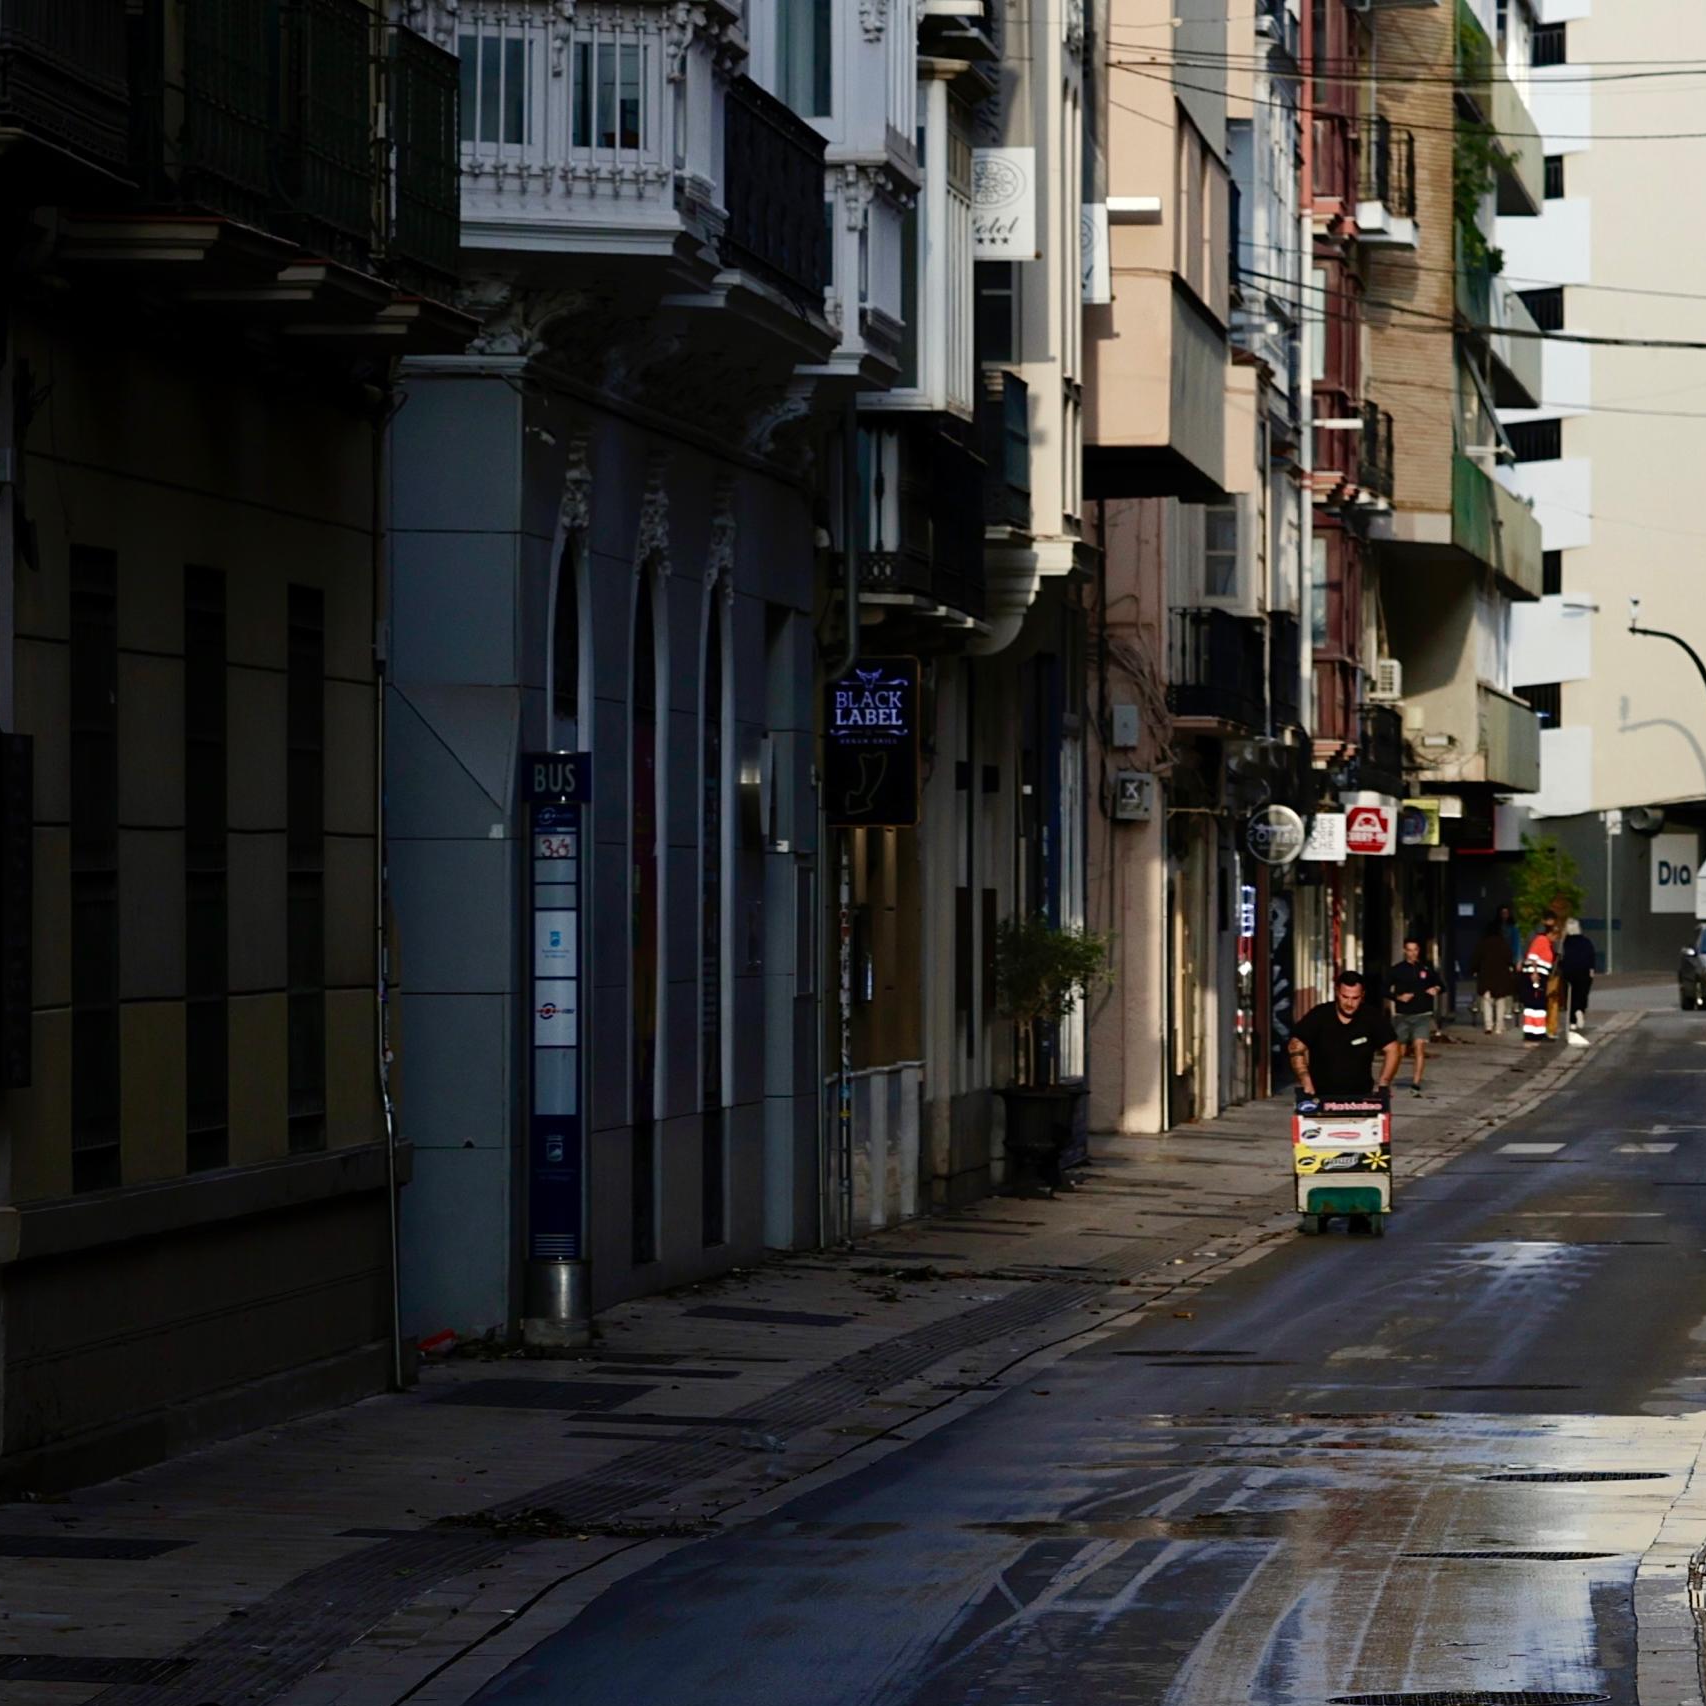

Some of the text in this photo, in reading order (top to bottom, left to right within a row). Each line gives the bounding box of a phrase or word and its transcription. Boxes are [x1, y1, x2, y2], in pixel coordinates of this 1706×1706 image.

[835, 690, 904, 709] BLACK
[835, 708, 904, 726] LABEL
[533, 763, 577, 793] BUS
